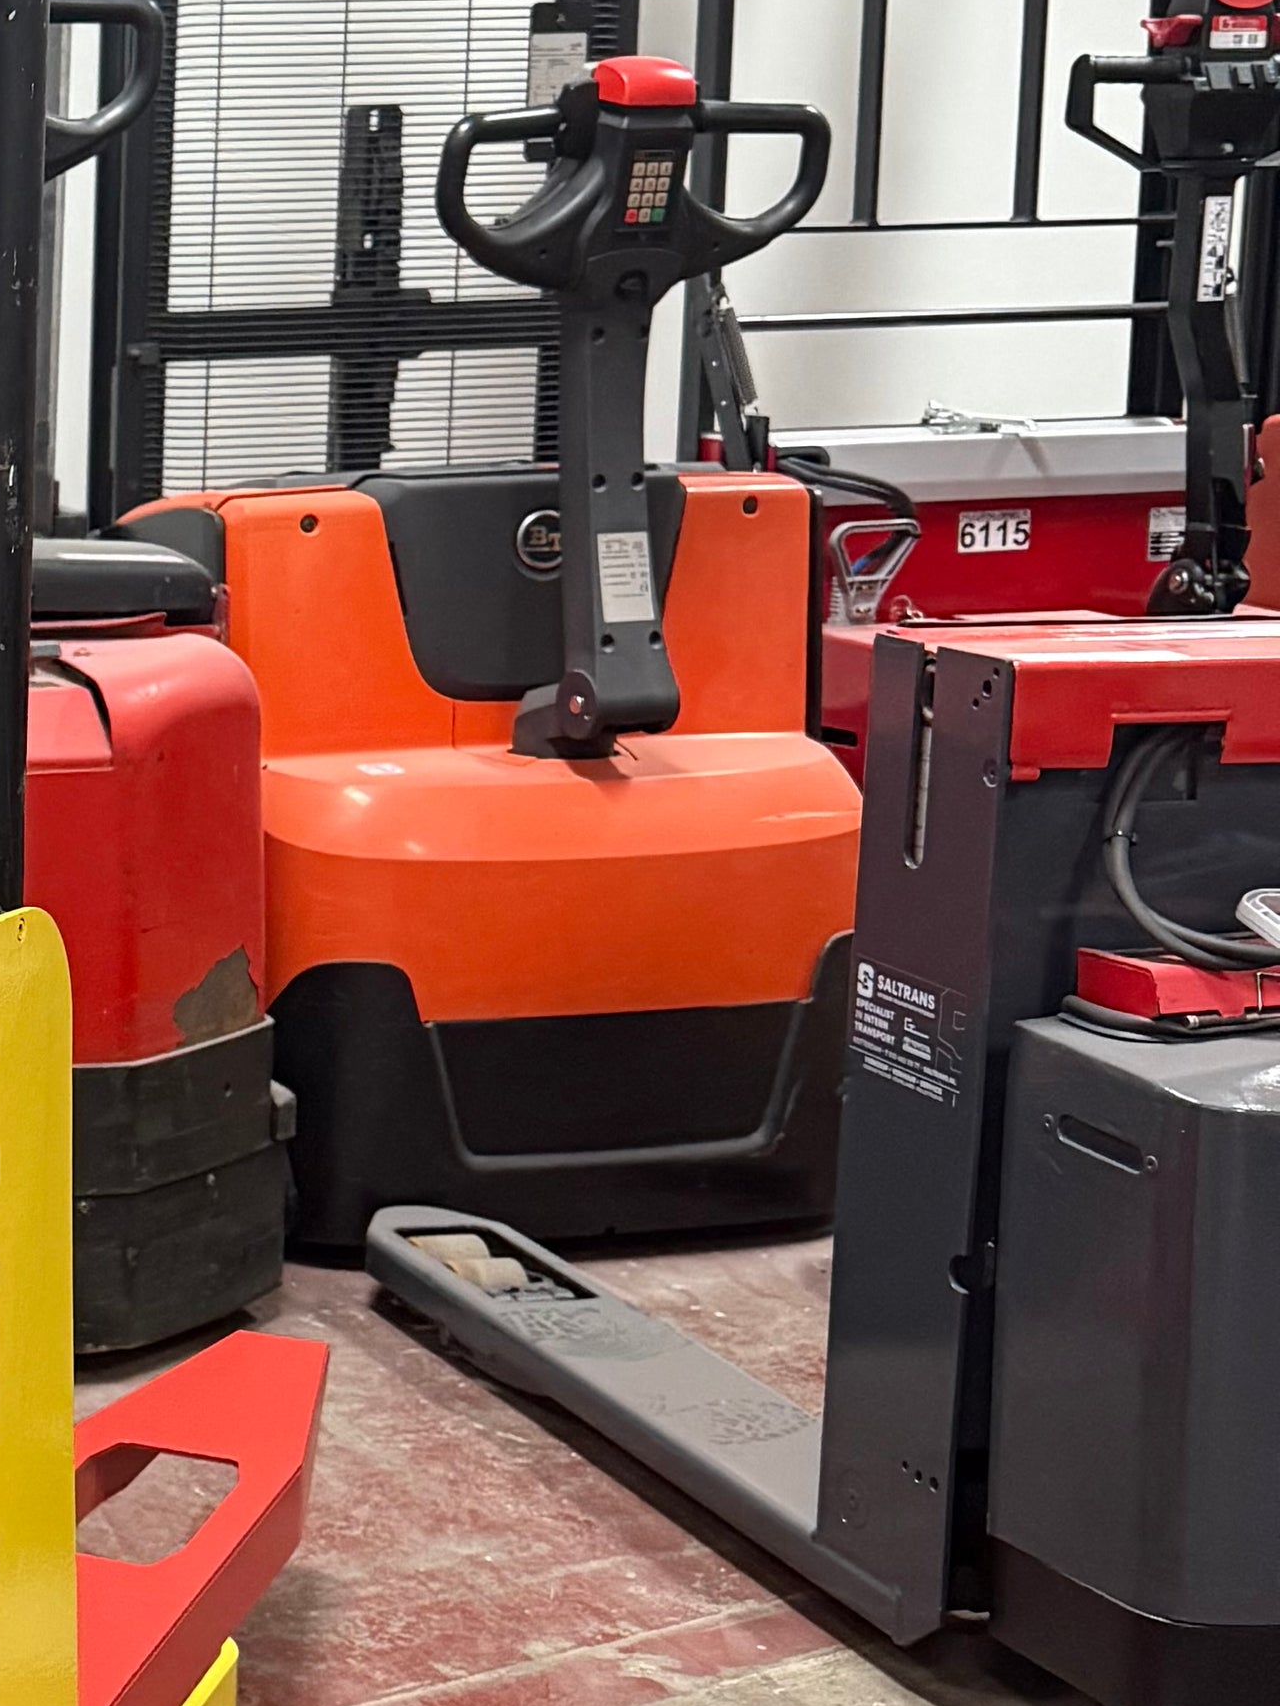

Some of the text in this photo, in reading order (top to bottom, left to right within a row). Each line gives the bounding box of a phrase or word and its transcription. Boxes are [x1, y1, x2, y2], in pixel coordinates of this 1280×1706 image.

[960, 520, 1030, 549] 6115
[877, 975, 936, 1010] SALTRANS
[854, 1021, 896, 1046] TRANSPORT
